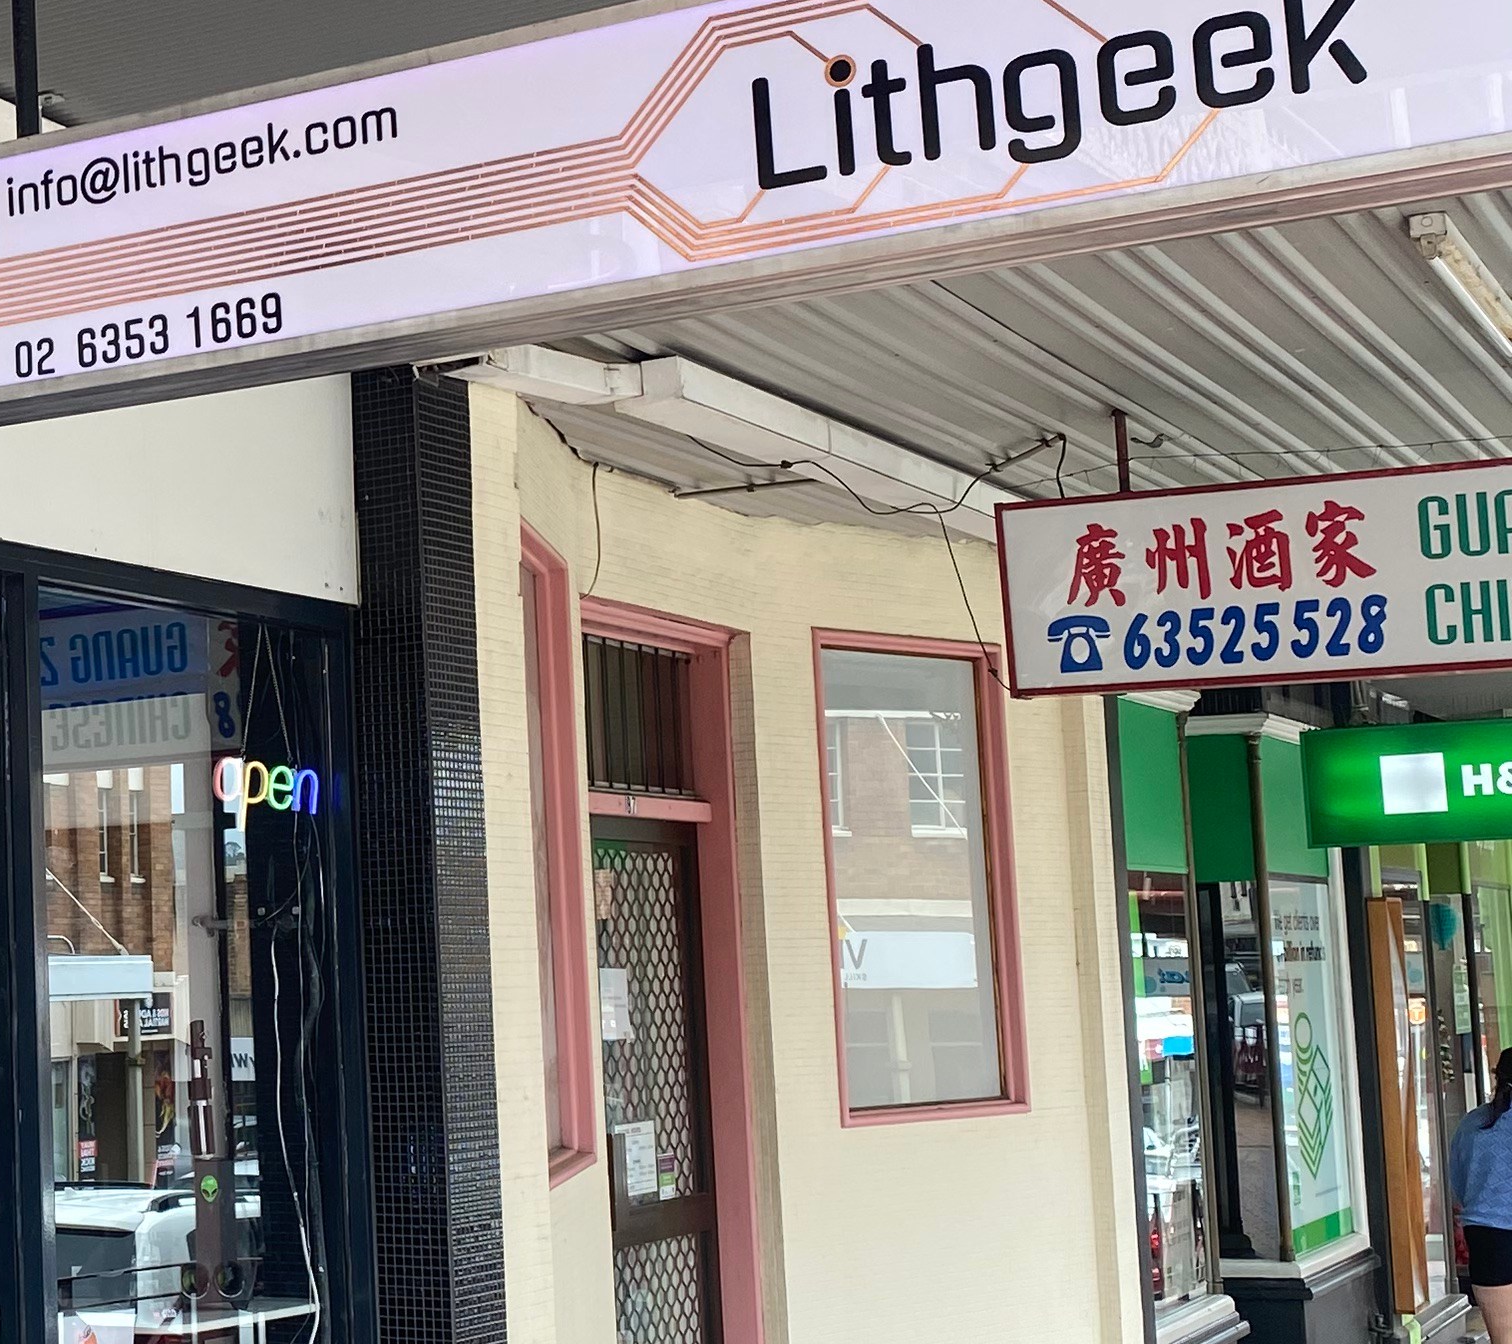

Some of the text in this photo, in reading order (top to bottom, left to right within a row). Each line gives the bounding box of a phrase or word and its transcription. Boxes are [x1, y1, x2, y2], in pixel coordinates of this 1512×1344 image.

[6, 103, 399, 218] info@lithgeek.com
[14, 291, 284, 379] 02 6353 1669
[1067, 500, 1377, 608] 廣州酒家
[213, 757, 319, 832] open
